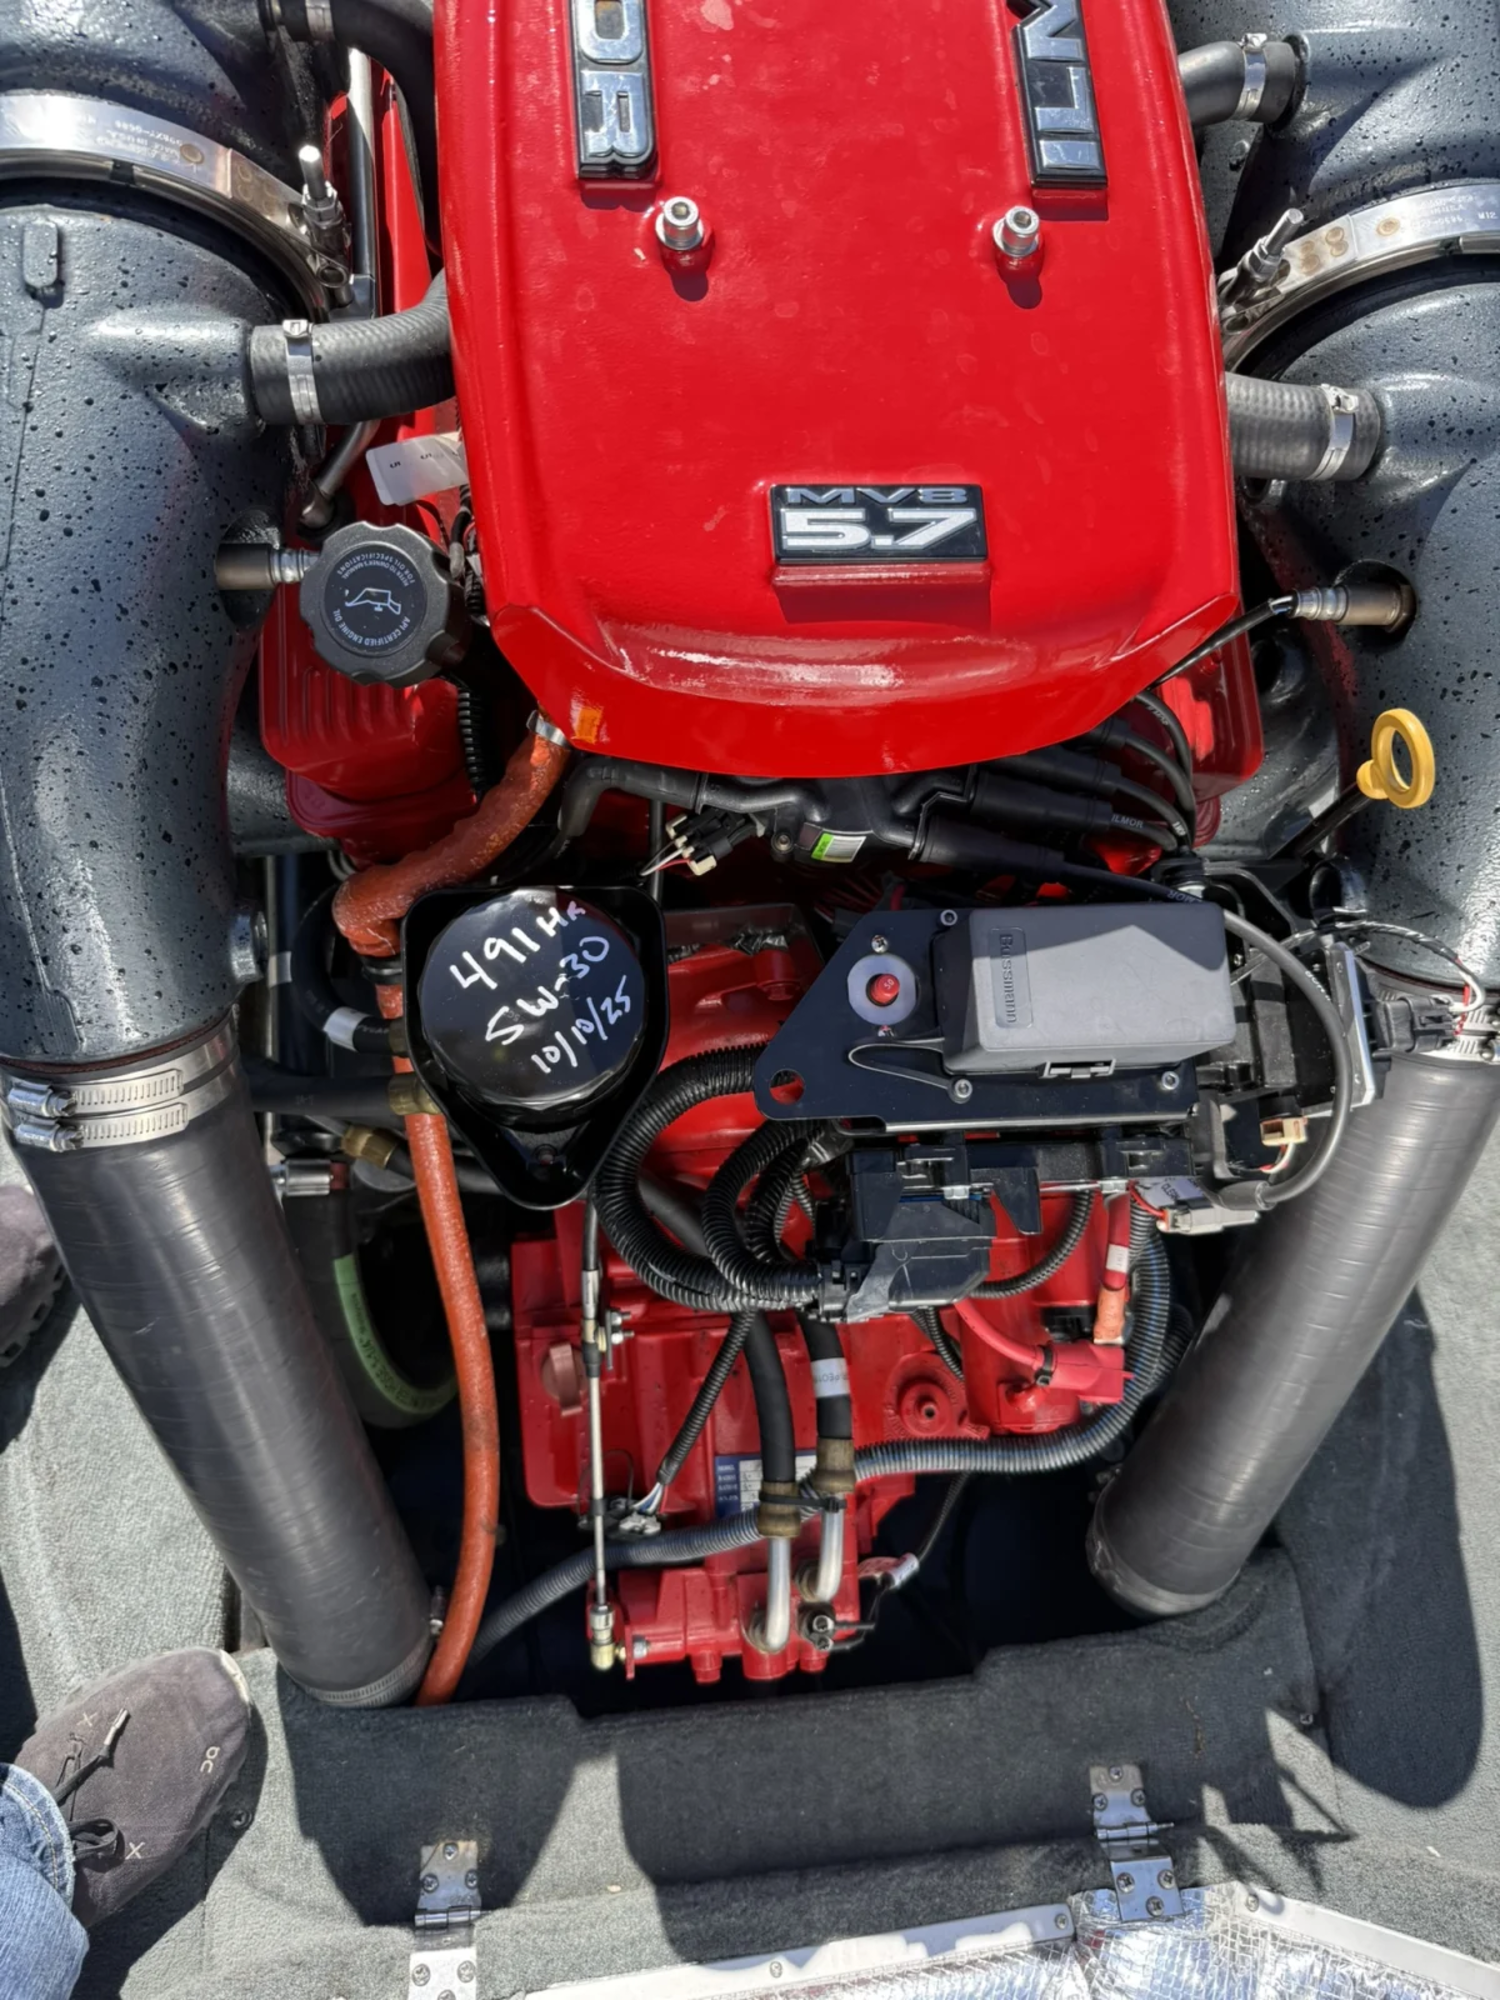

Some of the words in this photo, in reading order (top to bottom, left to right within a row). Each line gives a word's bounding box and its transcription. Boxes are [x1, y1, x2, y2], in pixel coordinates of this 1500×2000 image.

[786, 487, 968, 504] MV8
[780, 507, 978, 550] 5.7
[337, 553, 393, 575] SPECIFICATIONS
[342, 561, 364, 579] MANUAL
[395, 558, 406, 570] OIL
[333, 608, 342, 621] OIL
[400, 616, 410, 631] API
[339, 620, 363, 645] ENGINE
[364, 629, 402, 646] CERTIFIED
[1111, 814, 1144, 828] ILMOR
[450, 927, 540, 990] 491
[1000, 933, 1017, 1023] Bussmann
[531, 974, 632, 1074] 10/10/25
